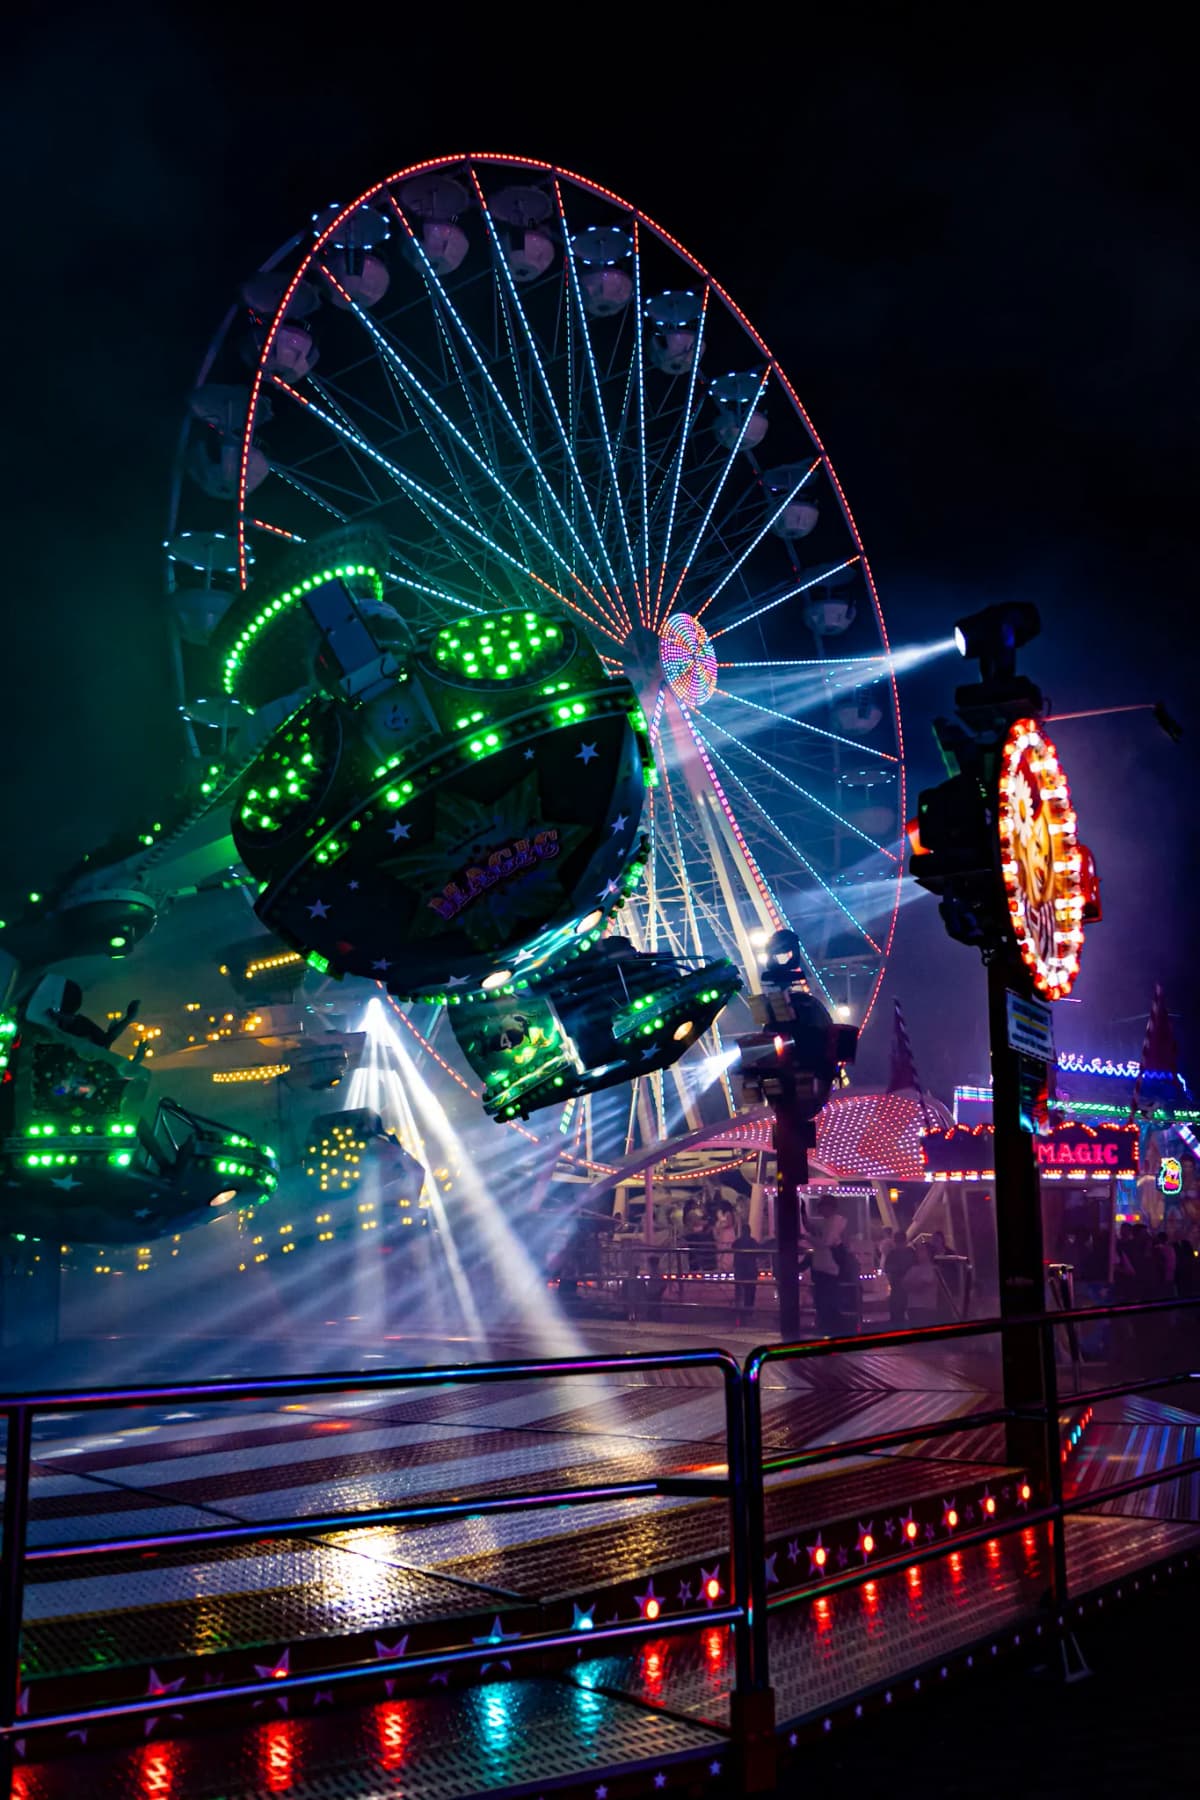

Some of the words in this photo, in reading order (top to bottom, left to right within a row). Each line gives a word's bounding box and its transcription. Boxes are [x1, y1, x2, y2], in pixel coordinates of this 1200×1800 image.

[427, 829, 561, 920] MAGIC
[500, 1031, 513, 1050] 4
[1036, 1143, 1119, 1165] MAGIC
